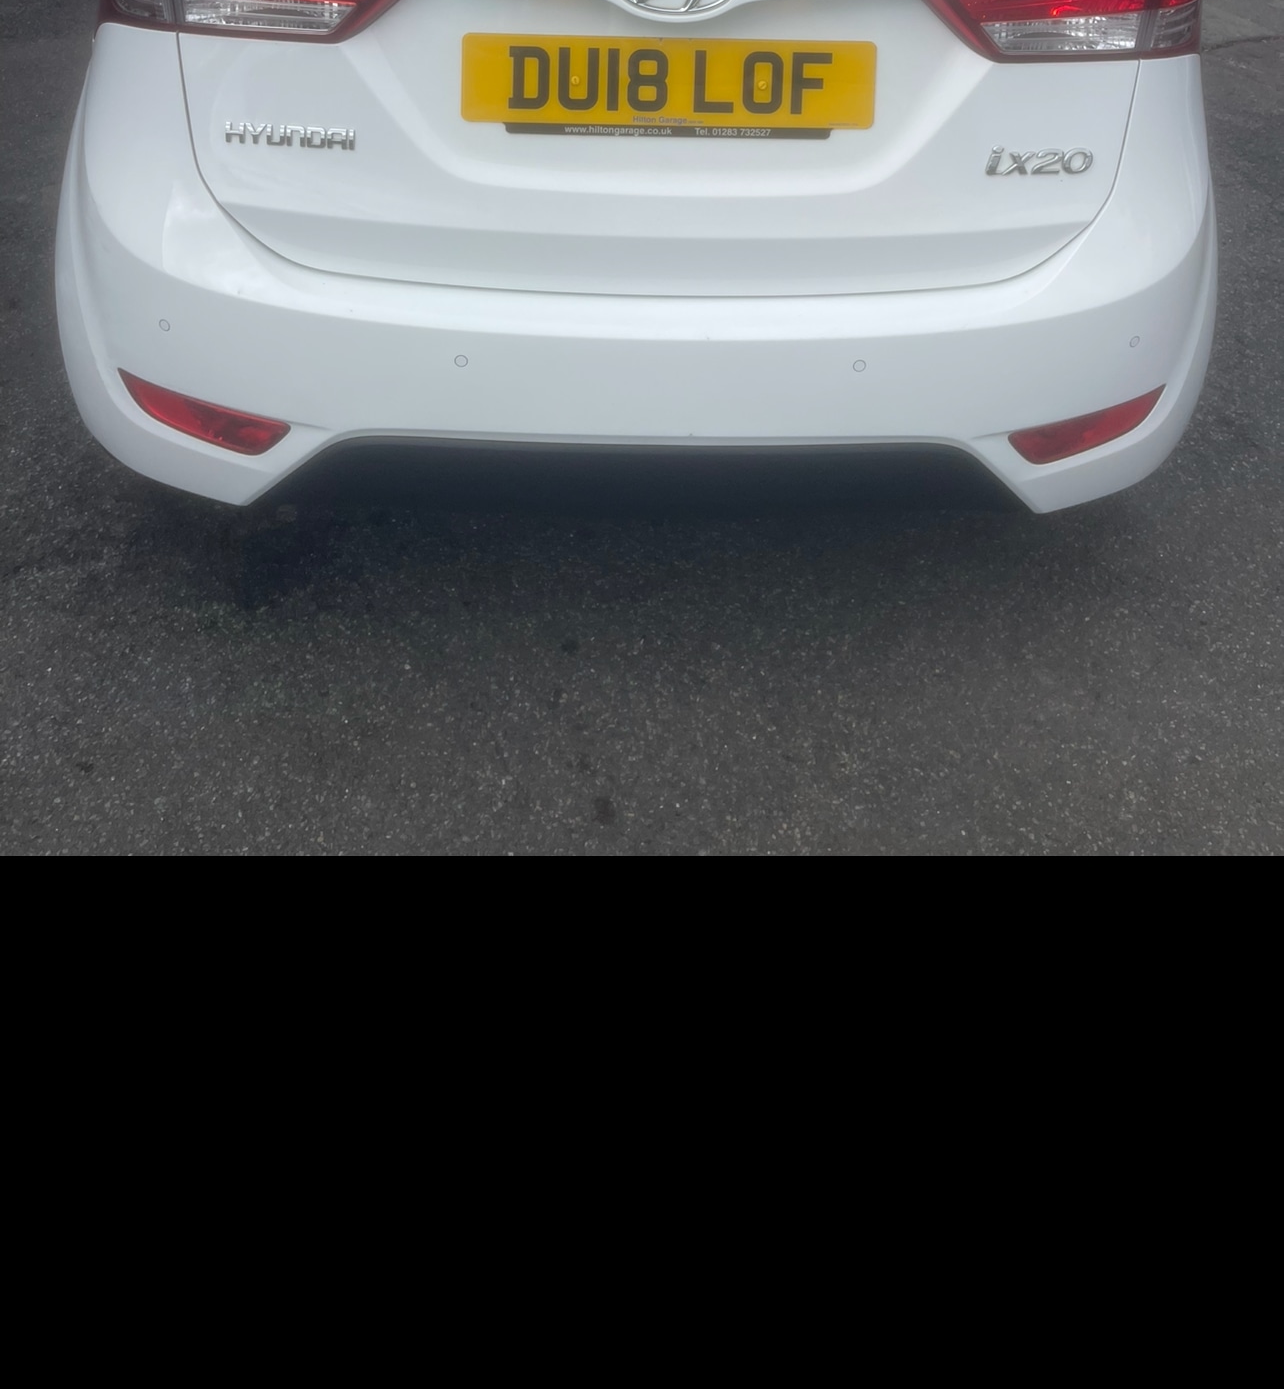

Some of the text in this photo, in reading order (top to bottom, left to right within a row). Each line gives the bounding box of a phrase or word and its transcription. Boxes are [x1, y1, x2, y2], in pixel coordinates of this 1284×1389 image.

[508, 45, 833, 115] DU18 LOF
[564, 125, 771, 137] www.hiltongarage.co.uk Tel. 01283 732527
[632, 115, 656, 124] Hilton
[658, 117, 688, 126] Garage
[225, 121, 355, 151] HYUNDAI
[985, 145, 1093, 176] ix20
